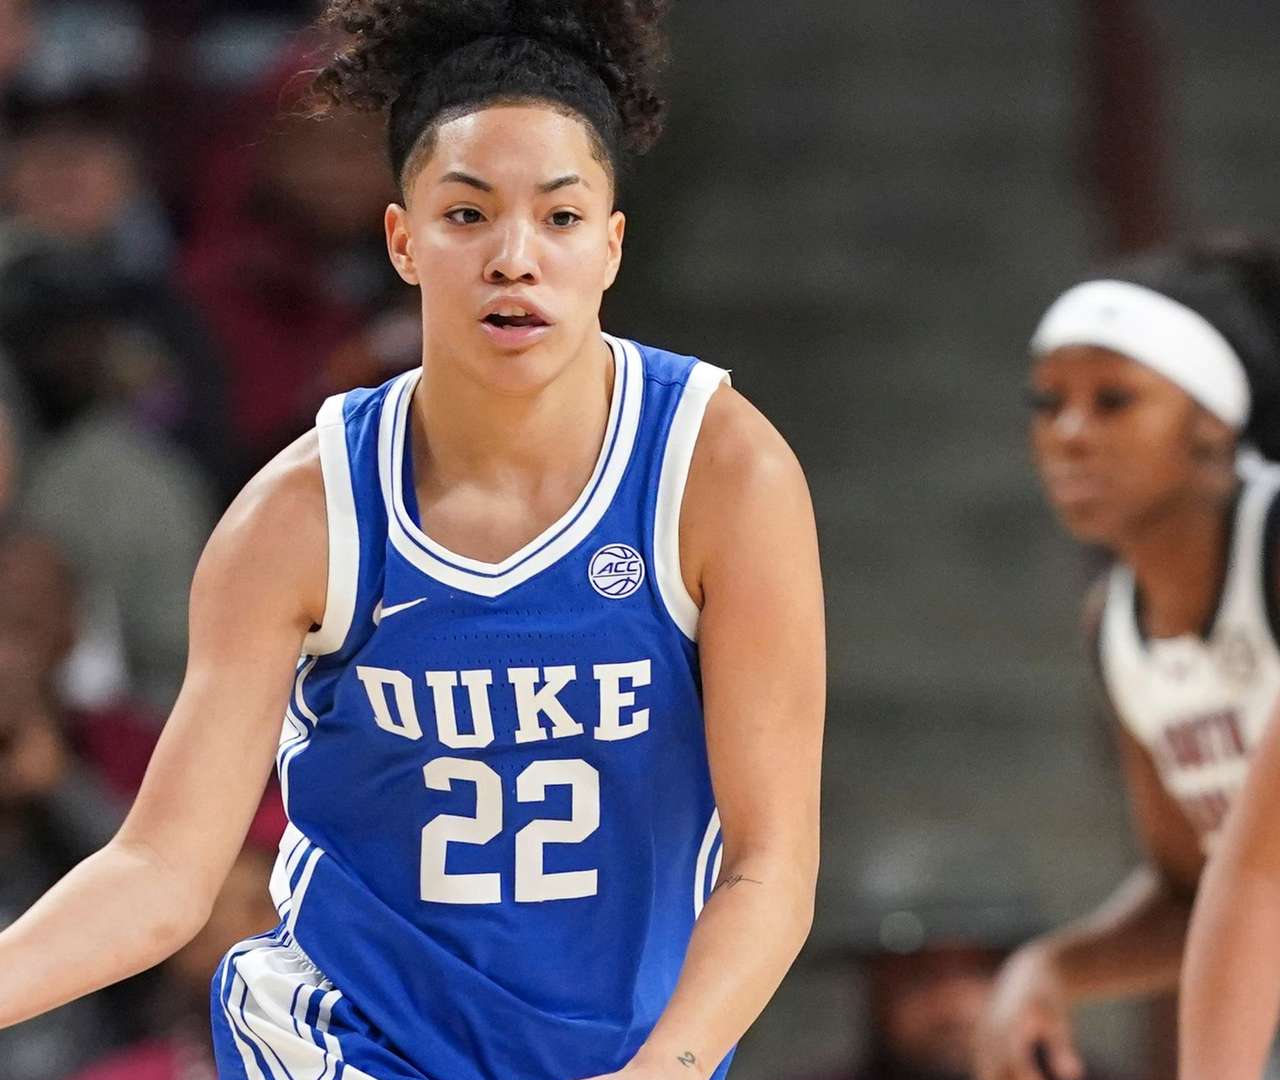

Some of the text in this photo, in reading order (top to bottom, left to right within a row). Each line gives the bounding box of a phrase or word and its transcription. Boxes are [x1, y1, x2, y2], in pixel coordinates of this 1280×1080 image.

[597, 560, 640, 575] ACC
[355, 659, 652, 749] DUKE
[420, 757, 601, 905] 22
